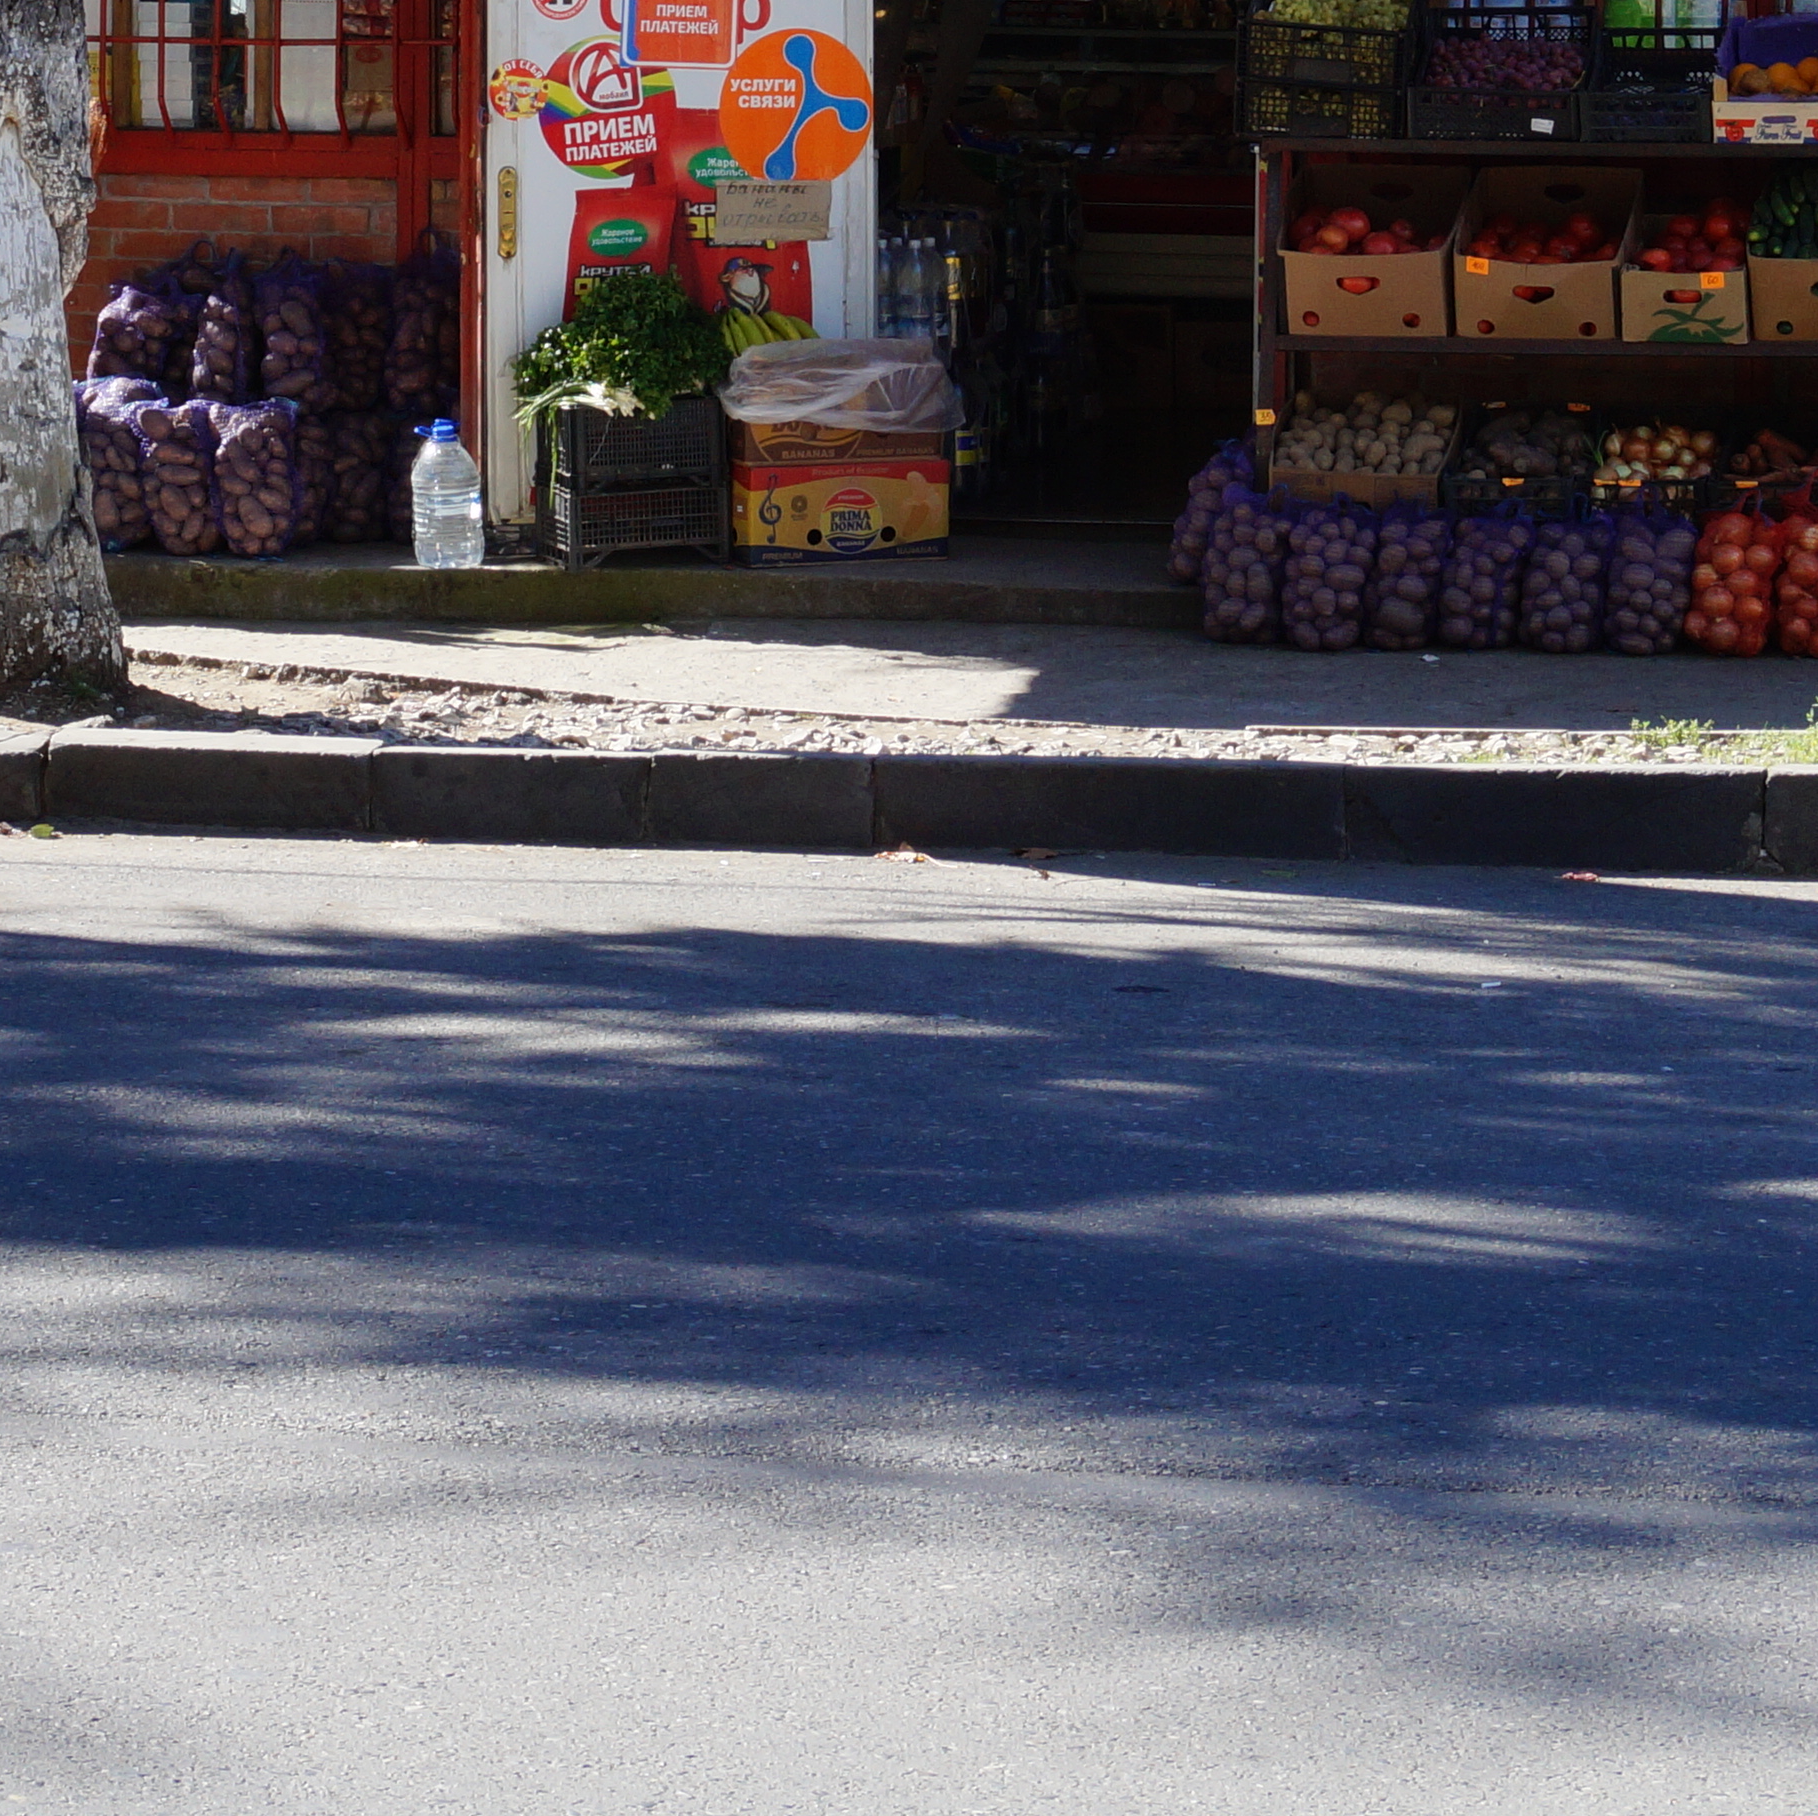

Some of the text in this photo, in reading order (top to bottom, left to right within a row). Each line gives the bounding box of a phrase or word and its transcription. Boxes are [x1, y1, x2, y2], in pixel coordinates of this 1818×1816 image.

[656, 4, 707, 18] ПРИЕМ
[640, 19, 719, 34] ПЛАТЕЖЕЙ
[730, 78, 796, 92] УСЛУГИ
[738, 95, 795, 108] СВЯЗИ
[564, 113, 656, 145] ПРИЕМ
[566, 135, 658, 162] ПЛАТЕЖЕЙ
[707, 157, 739, 168] Жаре
[781, 448, 836, 459] BANANAS
[830, 510, 871, 522] PRIMA
[830, 521, 873, 532] DONNA
